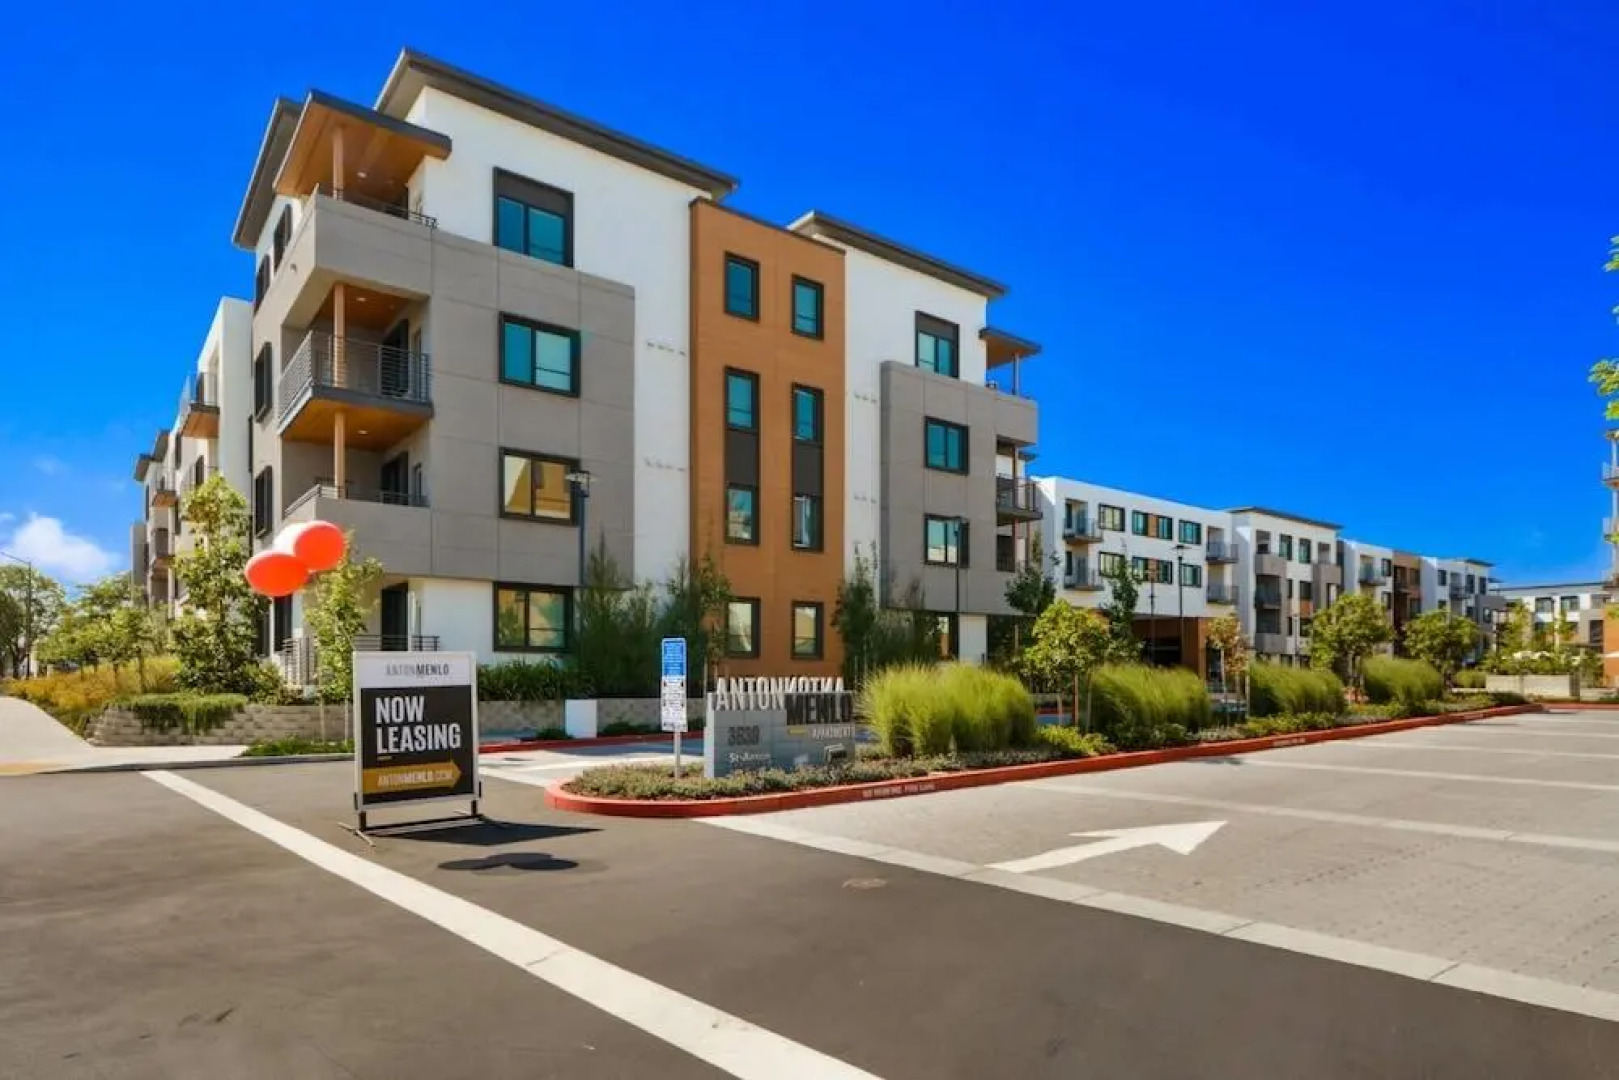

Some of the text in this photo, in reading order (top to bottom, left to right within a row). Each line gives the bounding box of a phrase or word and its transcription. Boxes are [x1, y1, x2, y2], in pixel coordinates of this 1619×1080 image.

[375, 695, 425, 724] NOW
[716, 676, 785, 710] ANTON
[785, 693, 854, 725] MENLO
[376, 723, 461, 754] LEASING
